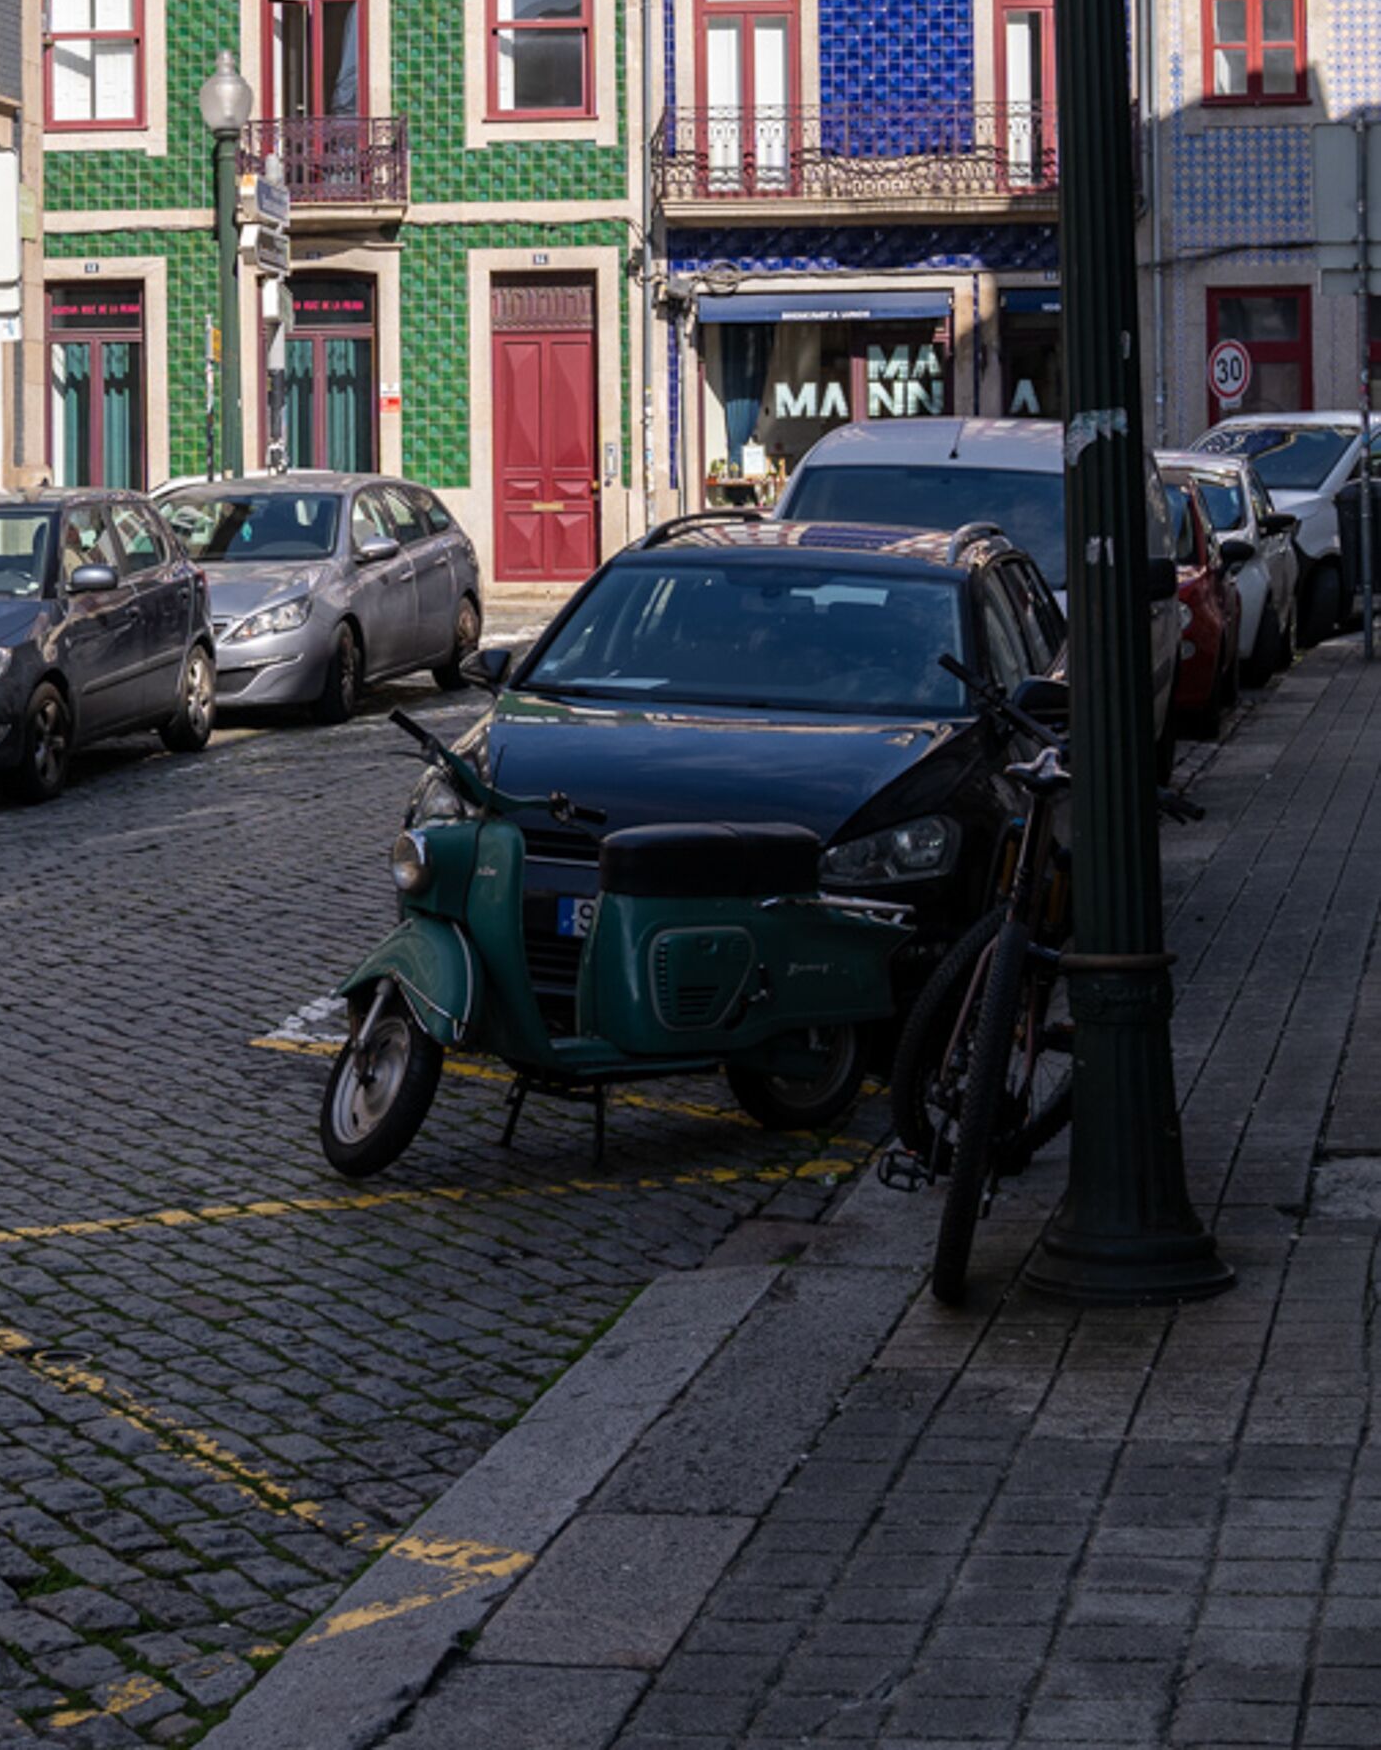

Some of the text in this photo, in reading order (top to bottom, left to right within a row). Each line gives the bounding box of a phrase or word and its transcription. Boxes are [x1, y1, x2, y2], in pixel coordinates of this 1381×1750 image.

[868, 345, 941, 379] MA
[1216, 356, 1242, 384] 30
[775, 382, 849, 419] MA
[868, 381, 945, 416] NN
[1009, 379, 1040, 414] A
